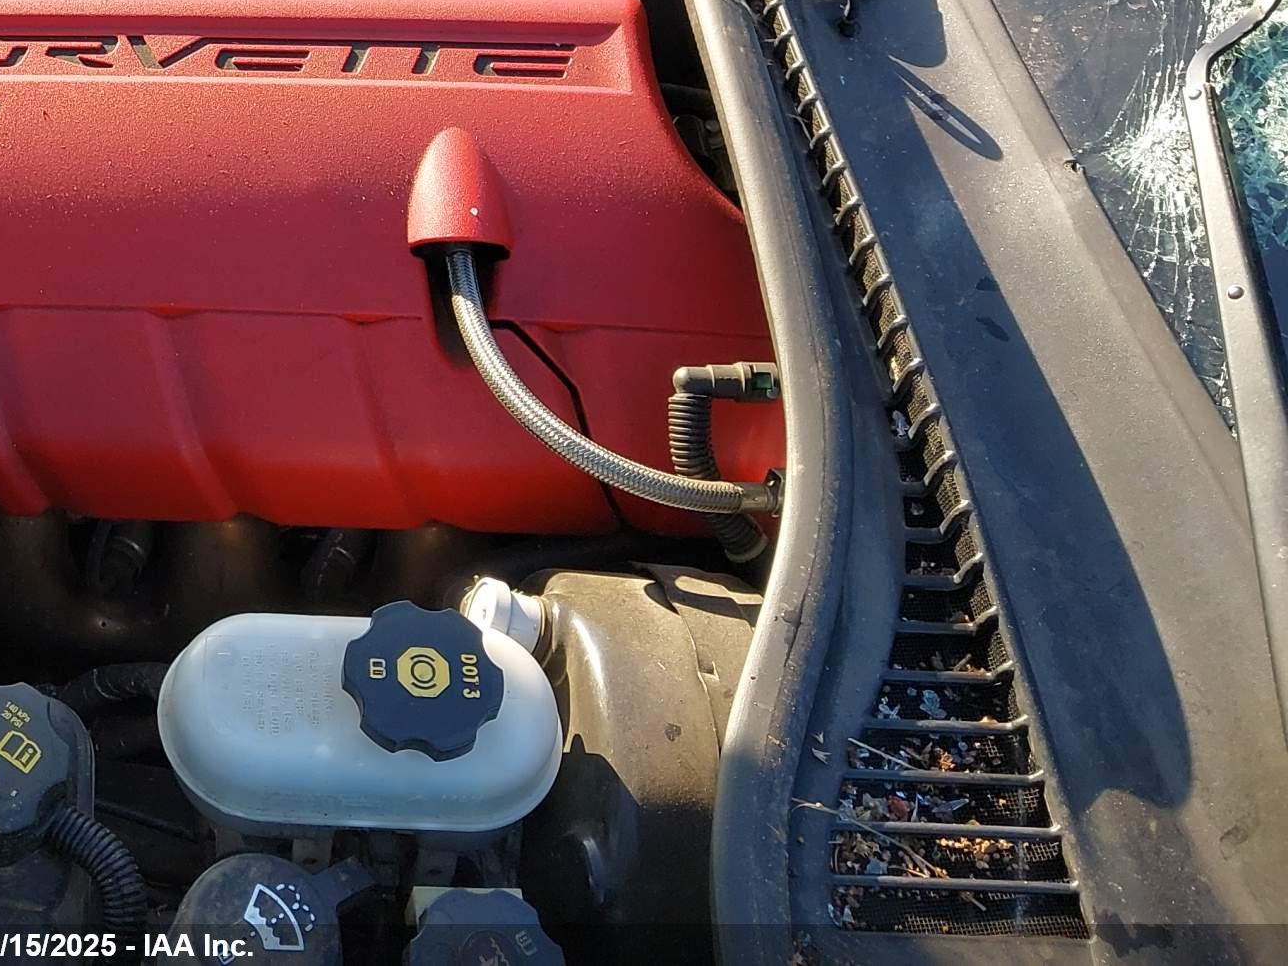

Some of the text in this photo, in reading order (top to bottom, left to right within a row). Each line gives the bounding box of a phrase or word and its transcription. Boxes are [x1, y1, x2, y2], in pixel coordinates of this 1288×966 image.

[460, 653, 481, 699] DOT 3
[6, 701, 19, 713] 140
[1, 709, 24, 729] 20 PSI
